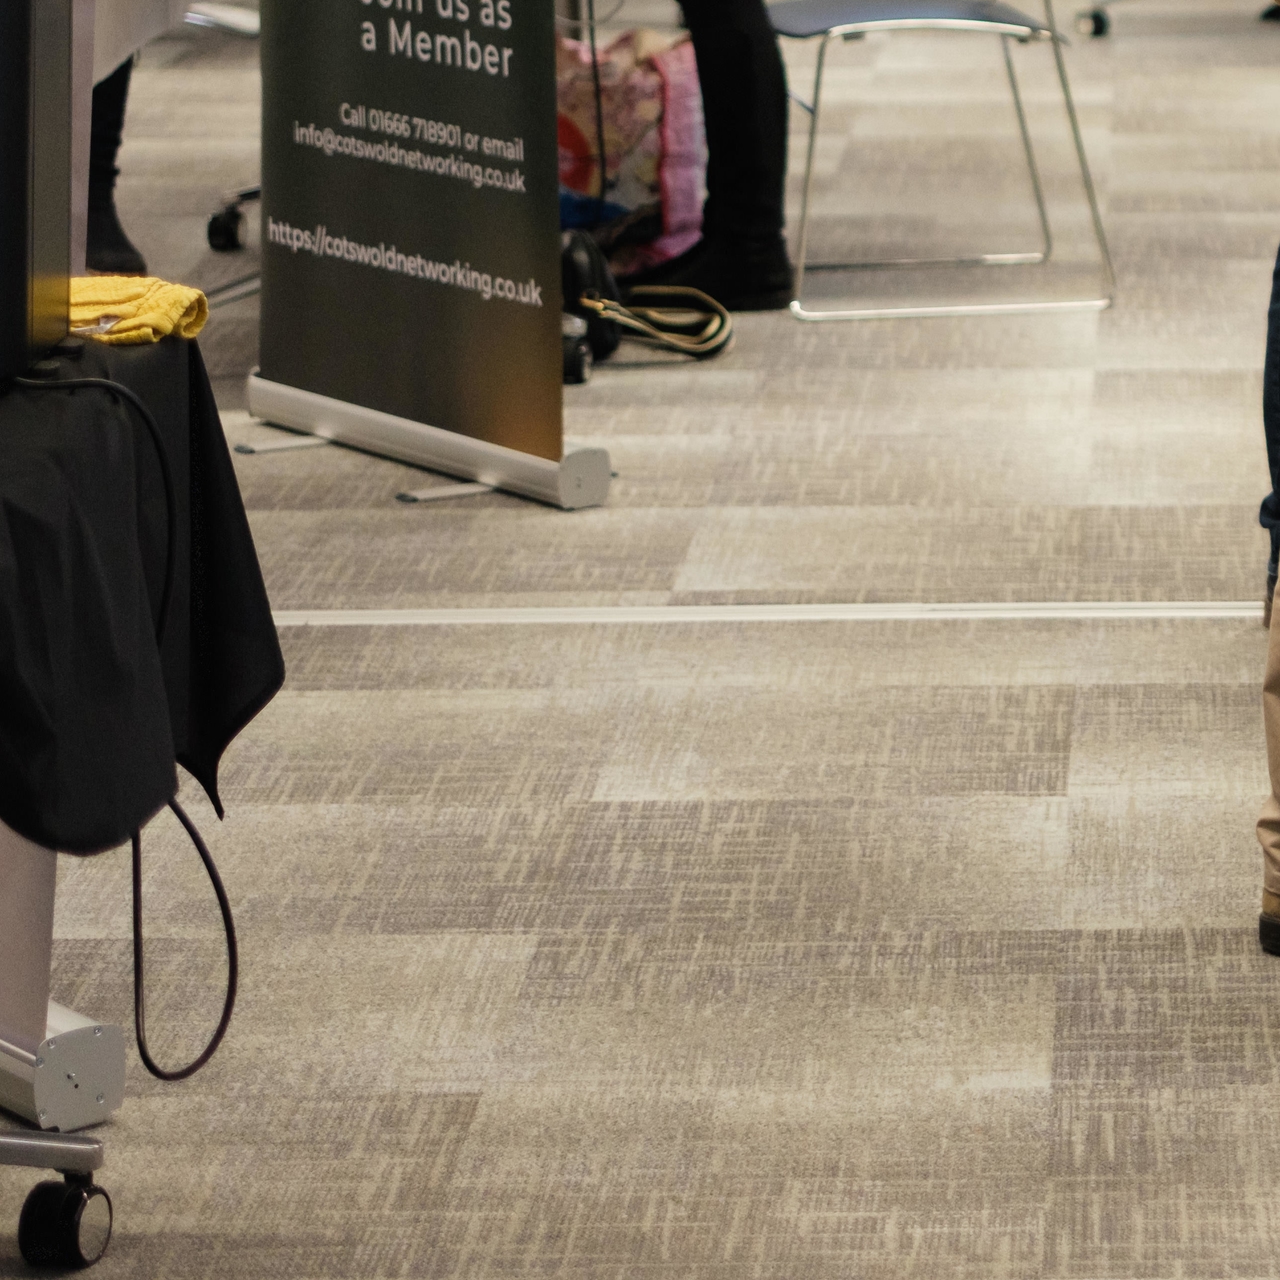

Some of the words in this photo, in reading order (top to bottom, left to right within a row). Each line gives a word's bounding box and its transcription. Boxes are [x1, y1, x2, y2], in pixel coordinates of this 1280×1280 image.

[360, 20, 377, 51] a
[388, 17, 514, 78] Member
[294, 120, 527, 194] info@cotswoldnetworking.co.uk
[340, 102, 366, 129] Call
[369, 108, 411, 139] 01666
[463, 132, 481, 152] or
[482, 137, 525, 163] email
[268, 216, 544, 308] https://cotswoldnetworking.co.uk
